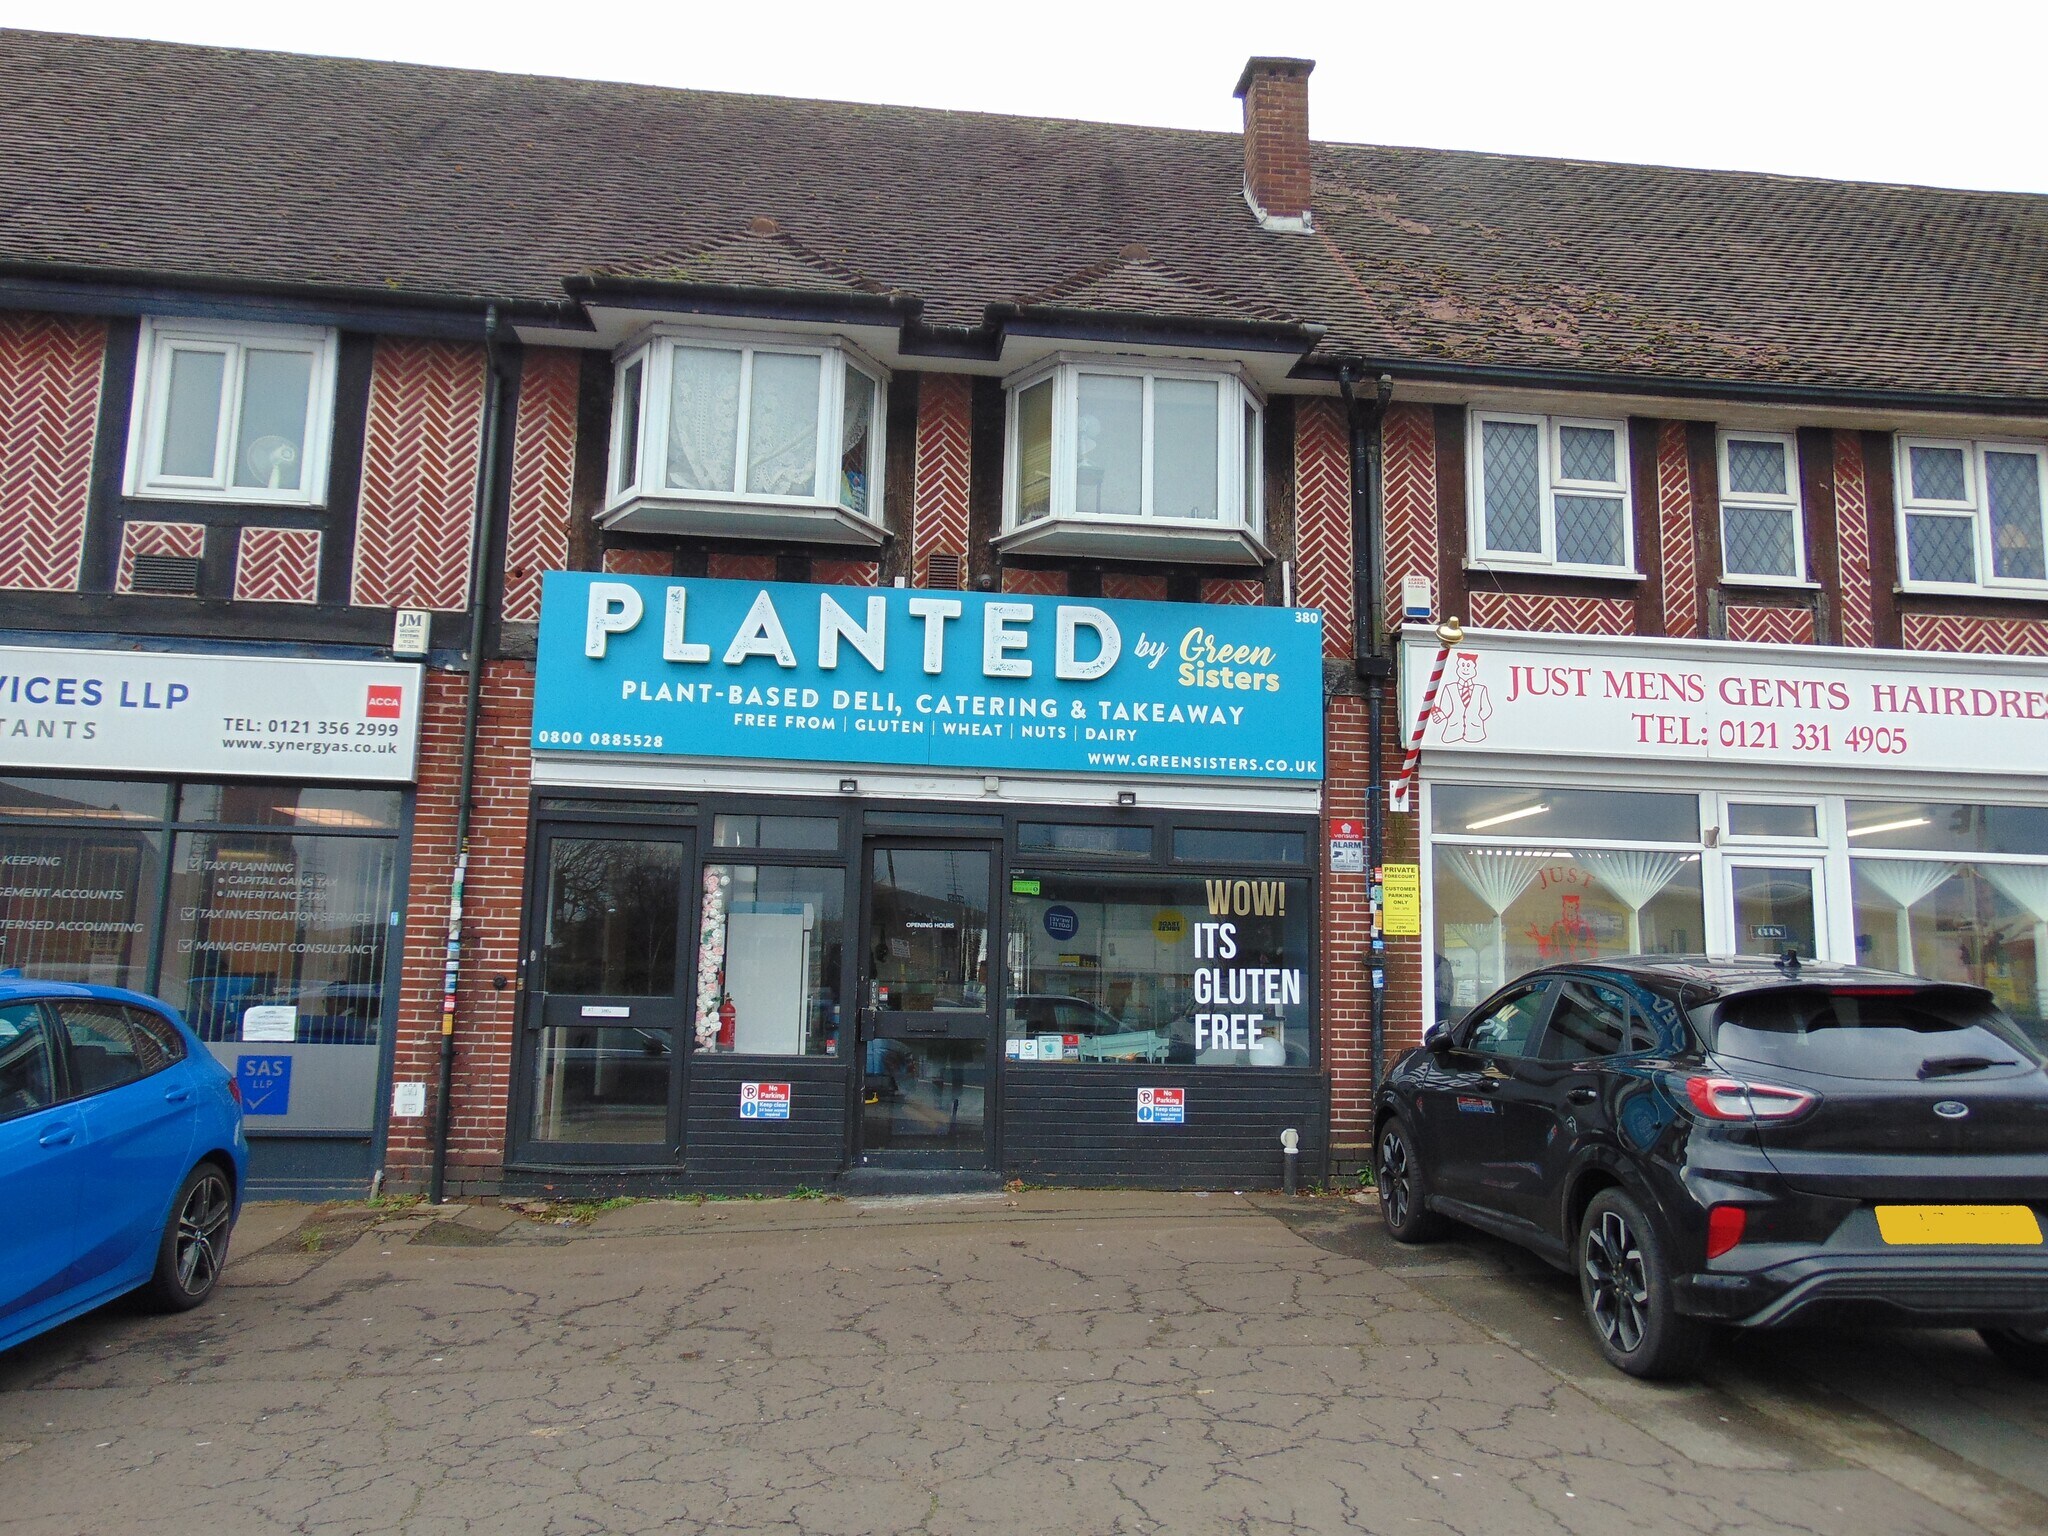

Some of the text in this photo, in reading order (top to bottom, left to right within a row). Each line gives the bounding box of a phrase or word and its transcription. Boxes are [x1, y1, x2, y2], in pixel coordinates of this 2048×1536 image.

[399, 614, 422, 627] JM
[1294, 612, 1318, 624] 380
[585, 582, 1277, 681] PLANTED by Green
[1178, 663, 1280, 692] Sisters
[119, 681, 189, 709] LLP
[1507, 665, 2048, 720] JUST MENS GENTS HAIRDRE
[368, 697, 399, 707] ACCA
[622, 680, 1244, 726] PLANT-BASED DELI, CATERING & TAKEAWAY
[223, 718, 399, 737] TEL: 0121 356 2999
[734, 713, 1137, 742] FREE FROM GLUTEN WHEAT NUTS DAIRY
[1631, 713, 1907, 755] TEL: 0121 331 4905
[222, 738, 397, 755] www.synergyas.co.uk
[538, 730, 664, 748] 0800 0885528
[1088, 752, 1317, 773] WWW.GREENSISTERS.CO.UK
[1332, 841, 1361, 849] ALARM
[204, 860, 294, 873] TAX PLANNING
[228, 875, 338, 887] CAPITAL GAINS TAX
[1538, 867, 1595, 889] JUST
[51, 889, 125, 900] ACCOUNTS
[226, 890, 304, 901] INHERITANCE
[1205, 879, 1286, 917] WOW!
[199, 908, 371, 923] TAX INVESTIGATION SERVICE
[56, 921, 144, 933] ACCOUNTING
[196, 941, 378, 955] MANAGEMENT CONSULTANCY
[1194, 922, 1237, 959] ITS
[1194, 968, 1300, 1005] GLUTEN
[1195, 1014, 1264, 1050] FREE
[245, 1060, 283, 1077] SAS
[252, 1080, 273, 1089] LLP
[761, 1092, 785, 1100] Parking
